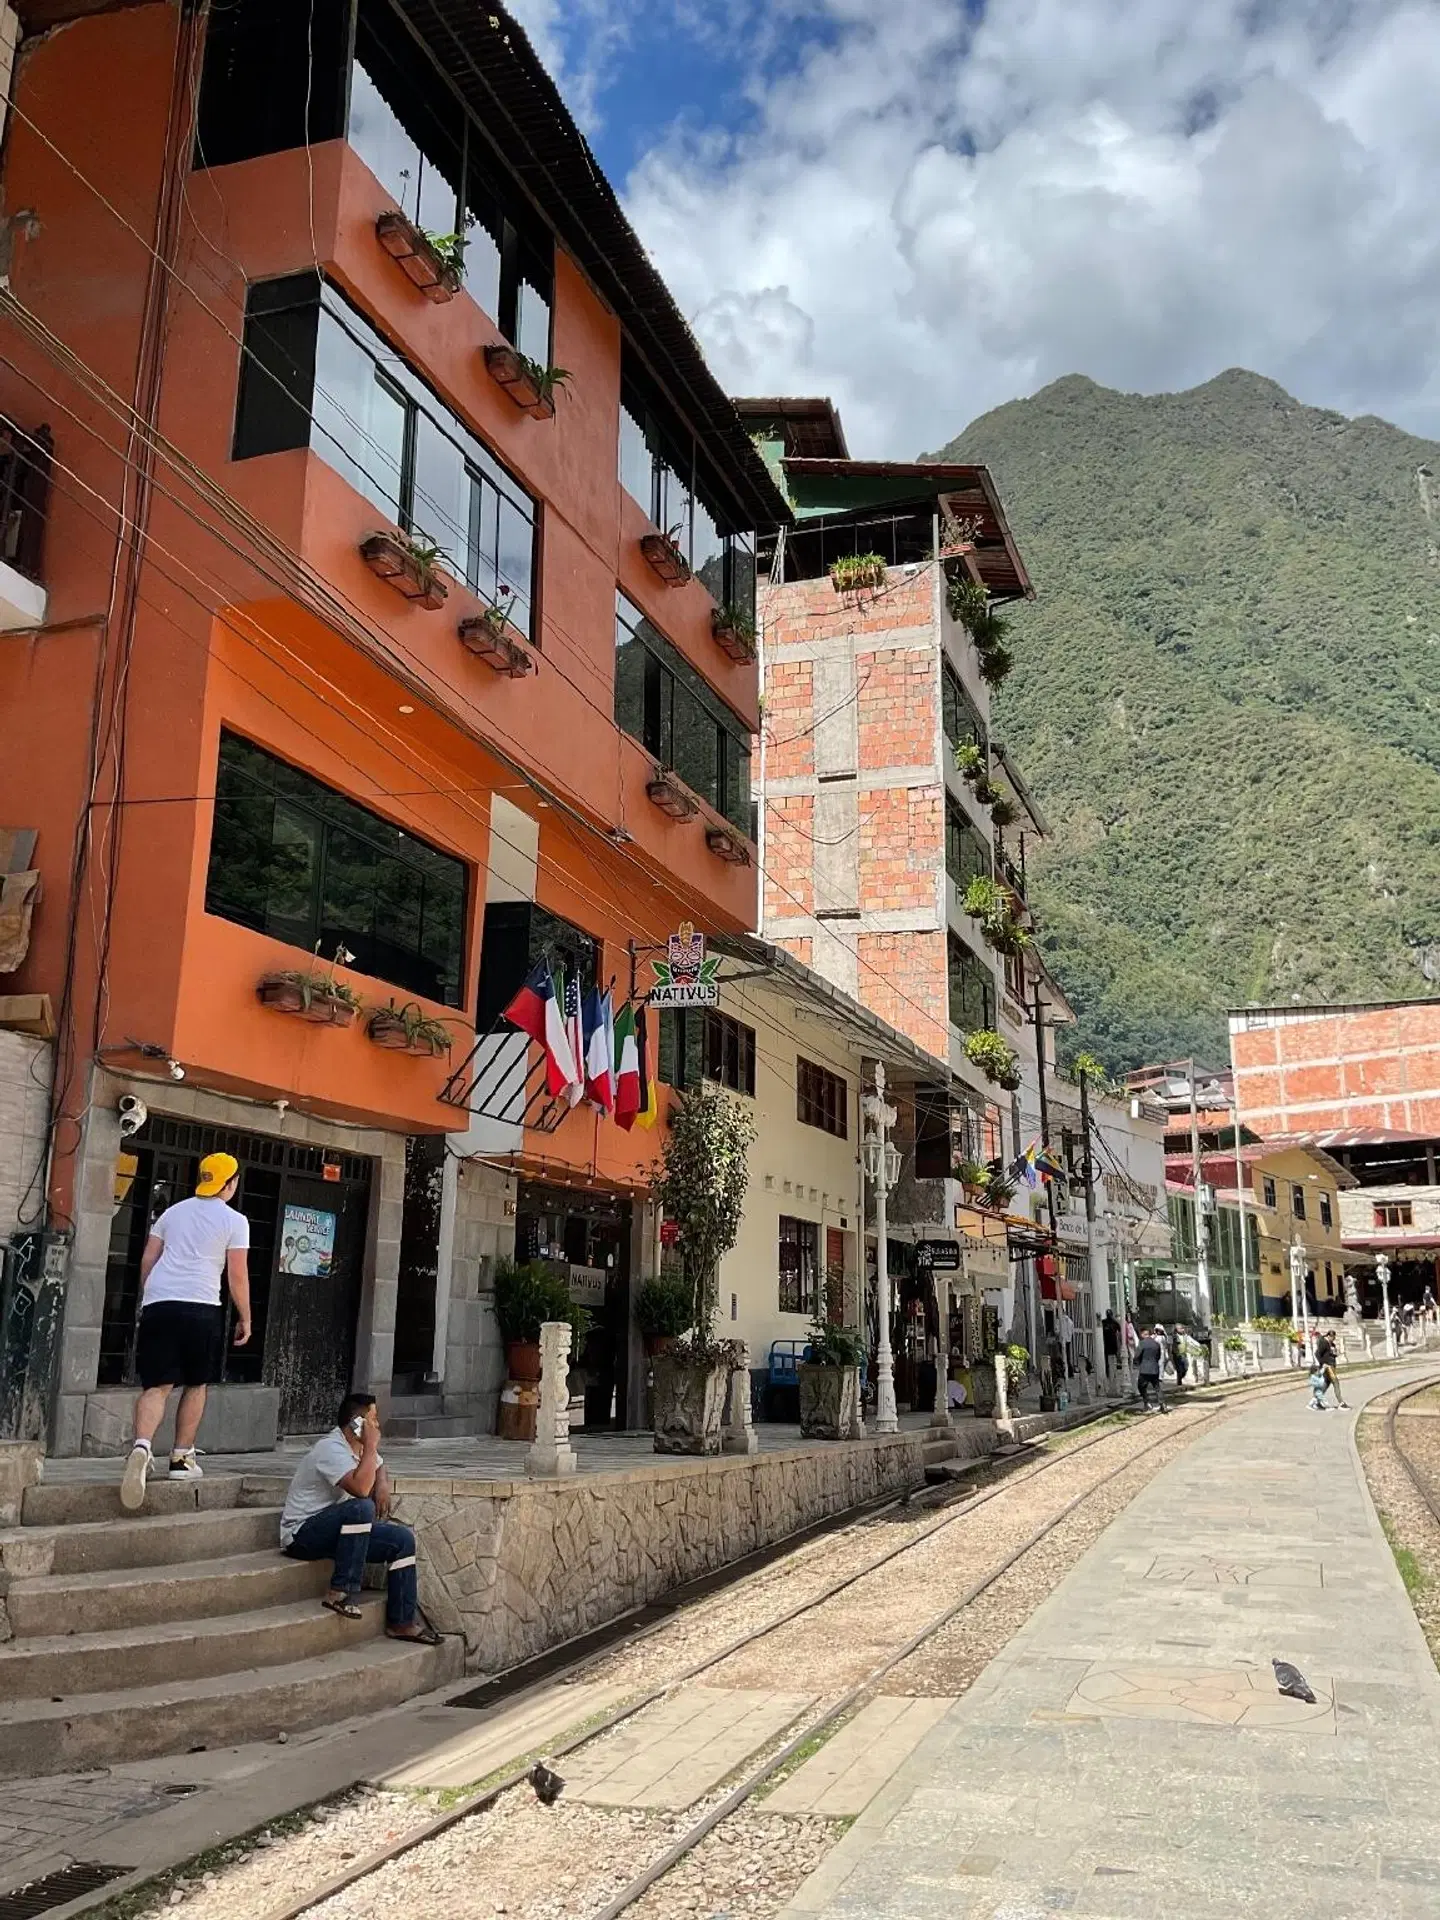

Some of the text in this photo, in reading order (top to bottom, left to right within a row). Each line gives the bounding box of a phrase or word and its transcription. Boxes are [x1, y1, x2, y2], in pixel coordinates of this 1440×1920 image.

[651, 986, 716, 1001] NATIVUS
[285, 1208, 320, 1224] LAUNDRY
[307, 1224, 330, 1236] SERVICE
[572, 1272, 601, 1290] NATIVUS
